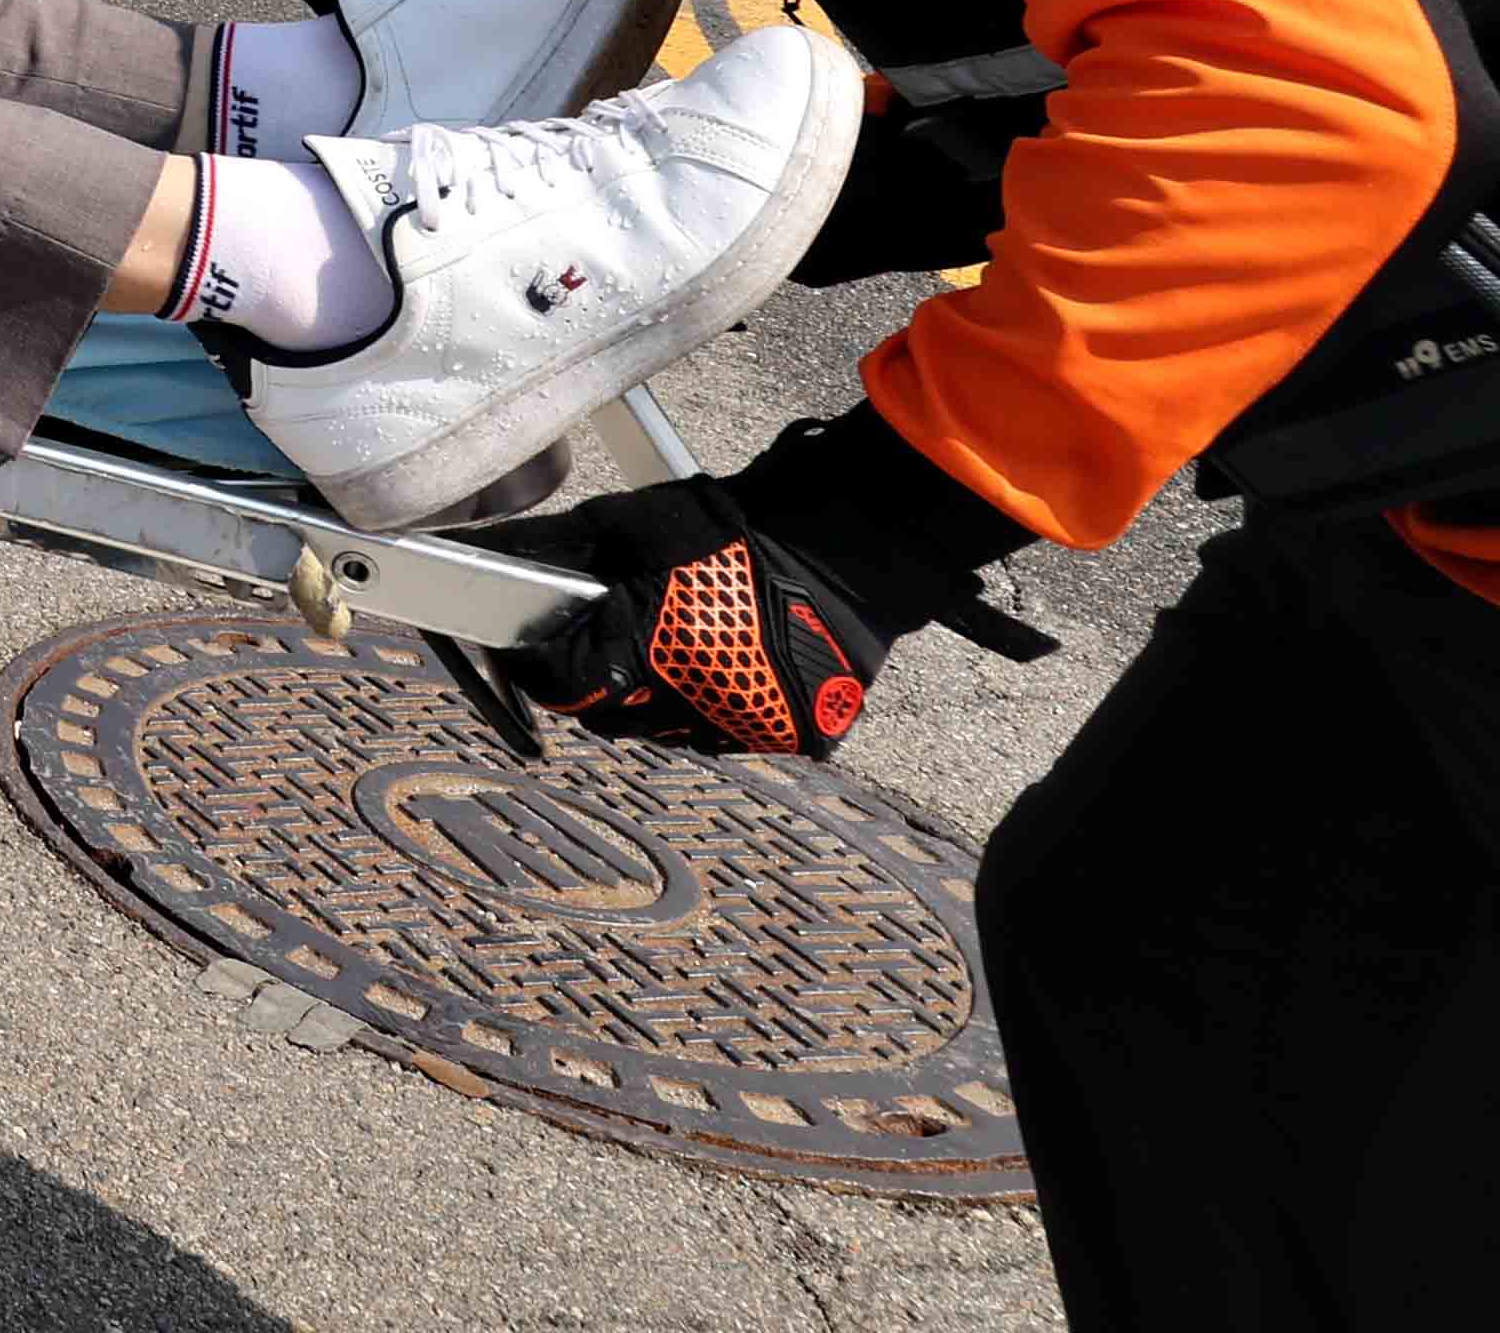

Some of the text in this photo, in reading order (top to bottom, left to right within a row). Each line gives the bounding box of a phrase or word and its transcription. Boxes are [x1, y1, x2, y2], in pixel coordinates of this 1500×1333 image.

[231, 85, 259, 158] ortif
[356, 158, 400, 206] COSTE
[200, 262, 239, 321] rtif
[1395, 333, 1499, 380] 119 EMS
